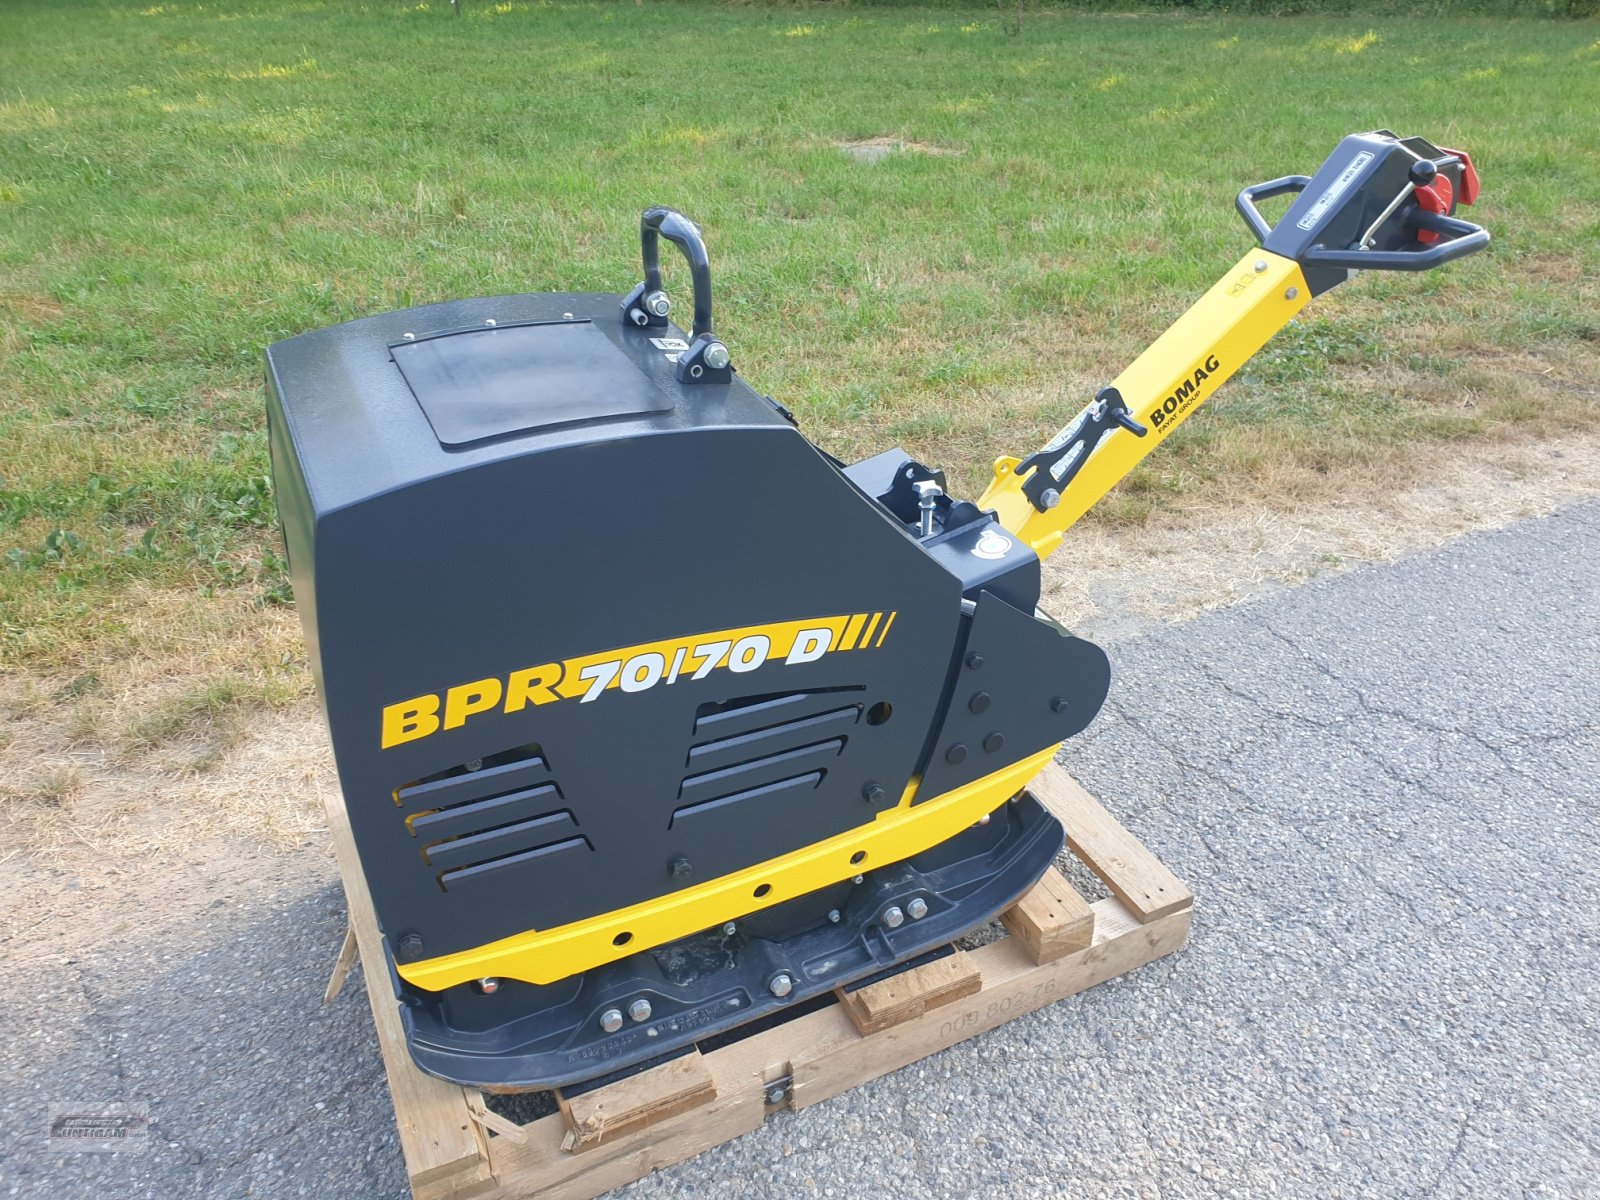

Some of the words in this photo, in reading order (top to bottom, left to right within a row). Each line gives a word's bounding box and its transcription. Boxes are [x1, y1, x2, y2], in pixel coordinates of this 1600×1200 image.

[1149, 354, 1220, 428] BOMAG
[1158, 413, 1178, 433] FAYAT
[1178, 390, 1201, 414] GROUP
[381, 662, 562, 750] BPR
[784, 627, 833, 666] D
